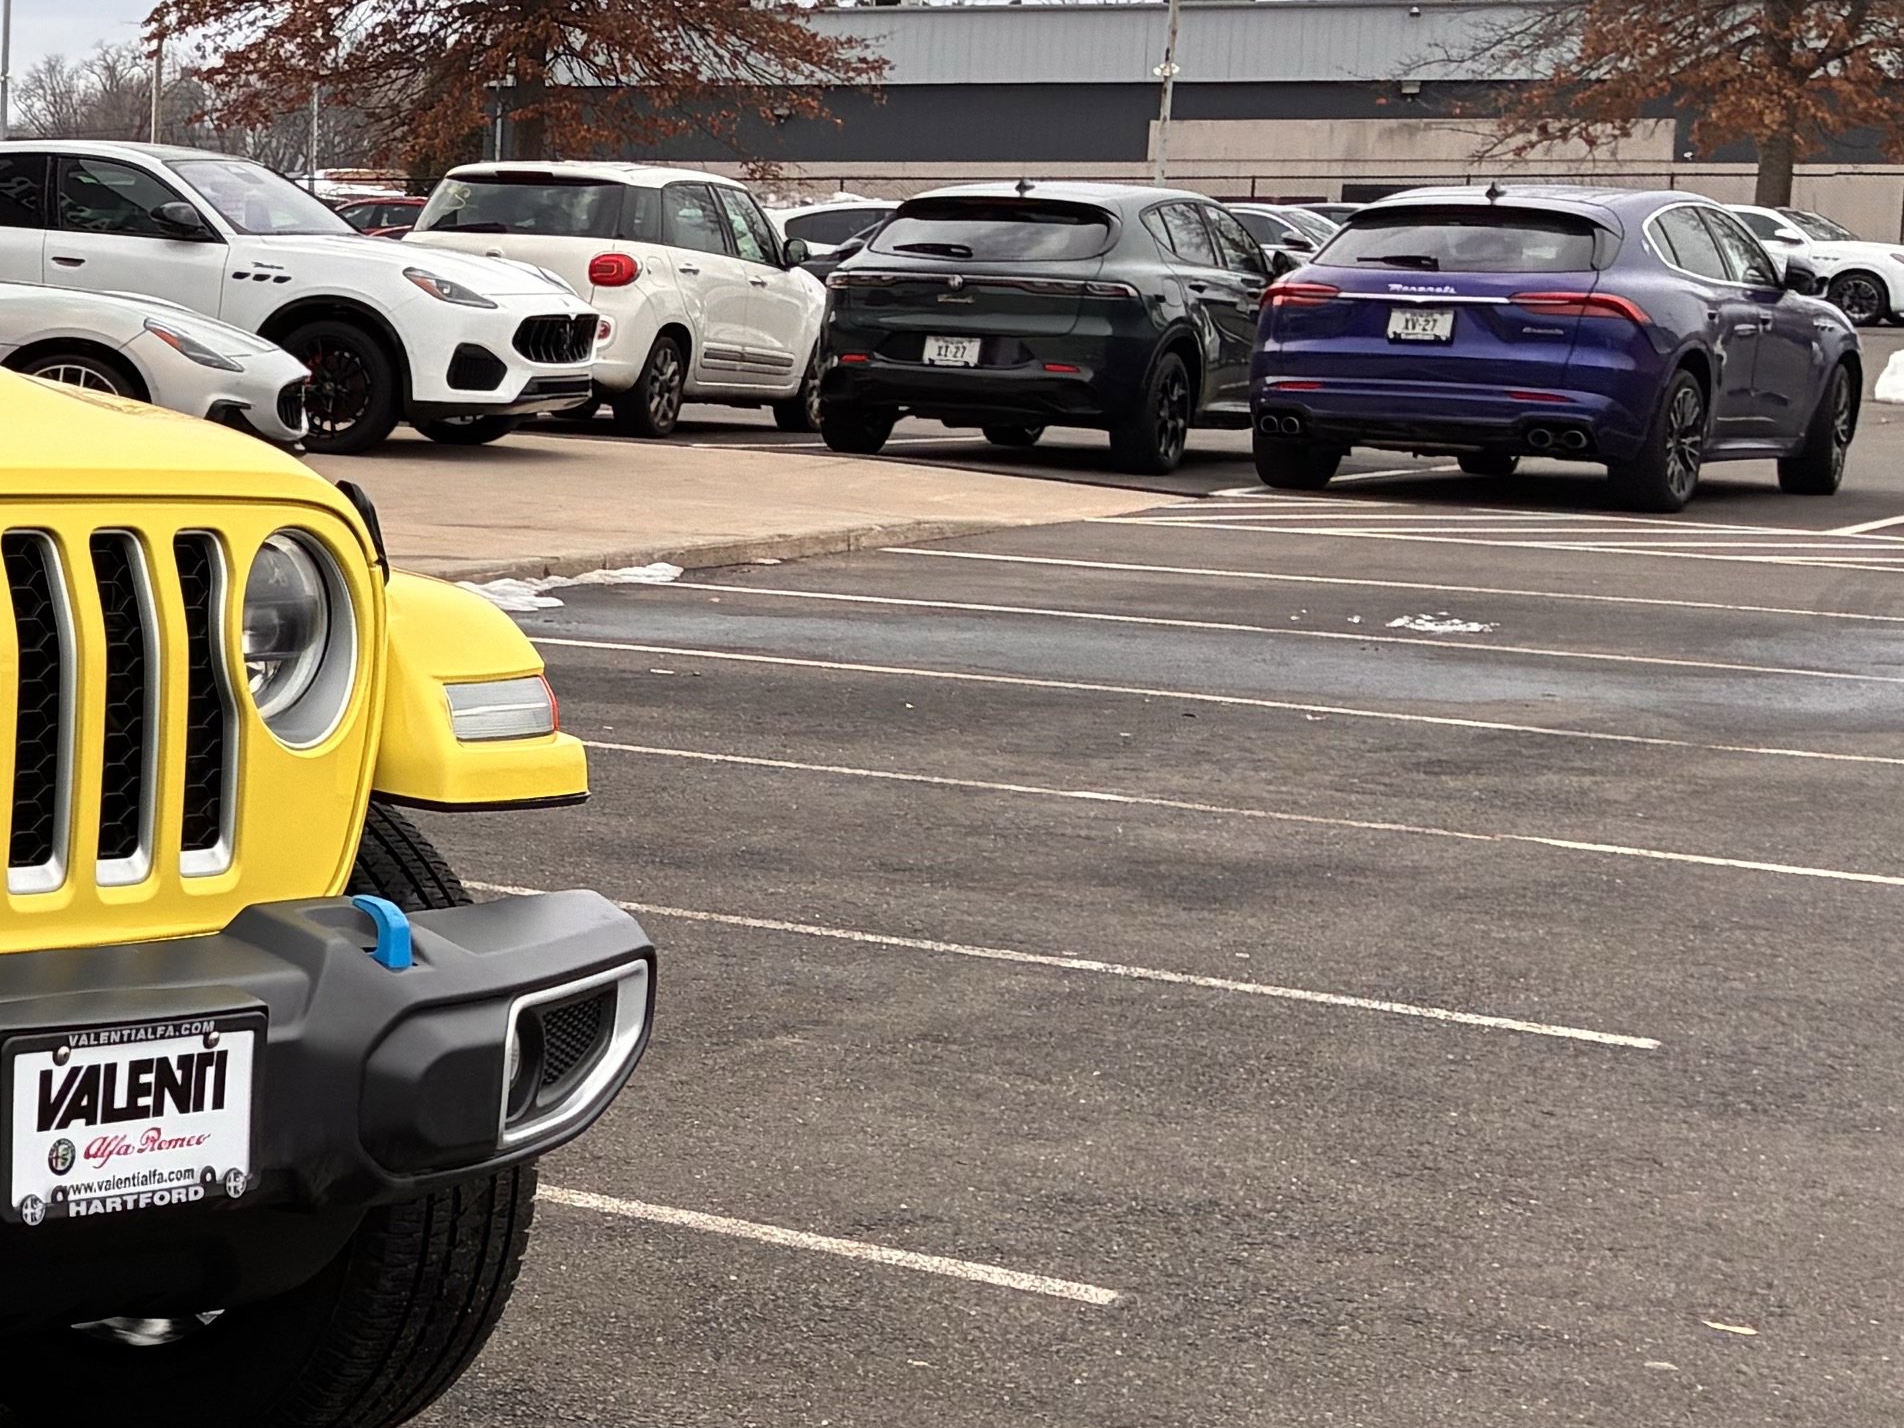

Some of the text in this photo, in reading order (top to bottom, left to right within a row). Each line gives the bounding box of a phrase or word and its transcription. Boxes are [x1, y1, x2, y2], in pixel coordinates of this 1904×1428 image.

[68, 1020, 215, 1047] VALENTIALFA.COM
[36, 1049, 229, 1133] VALENTI
[83, 1132, 135, 1169] Alfa
[137, 1127, 212, 1154] Romeo
[68, 1186, 205, 1218] HARTFORD
